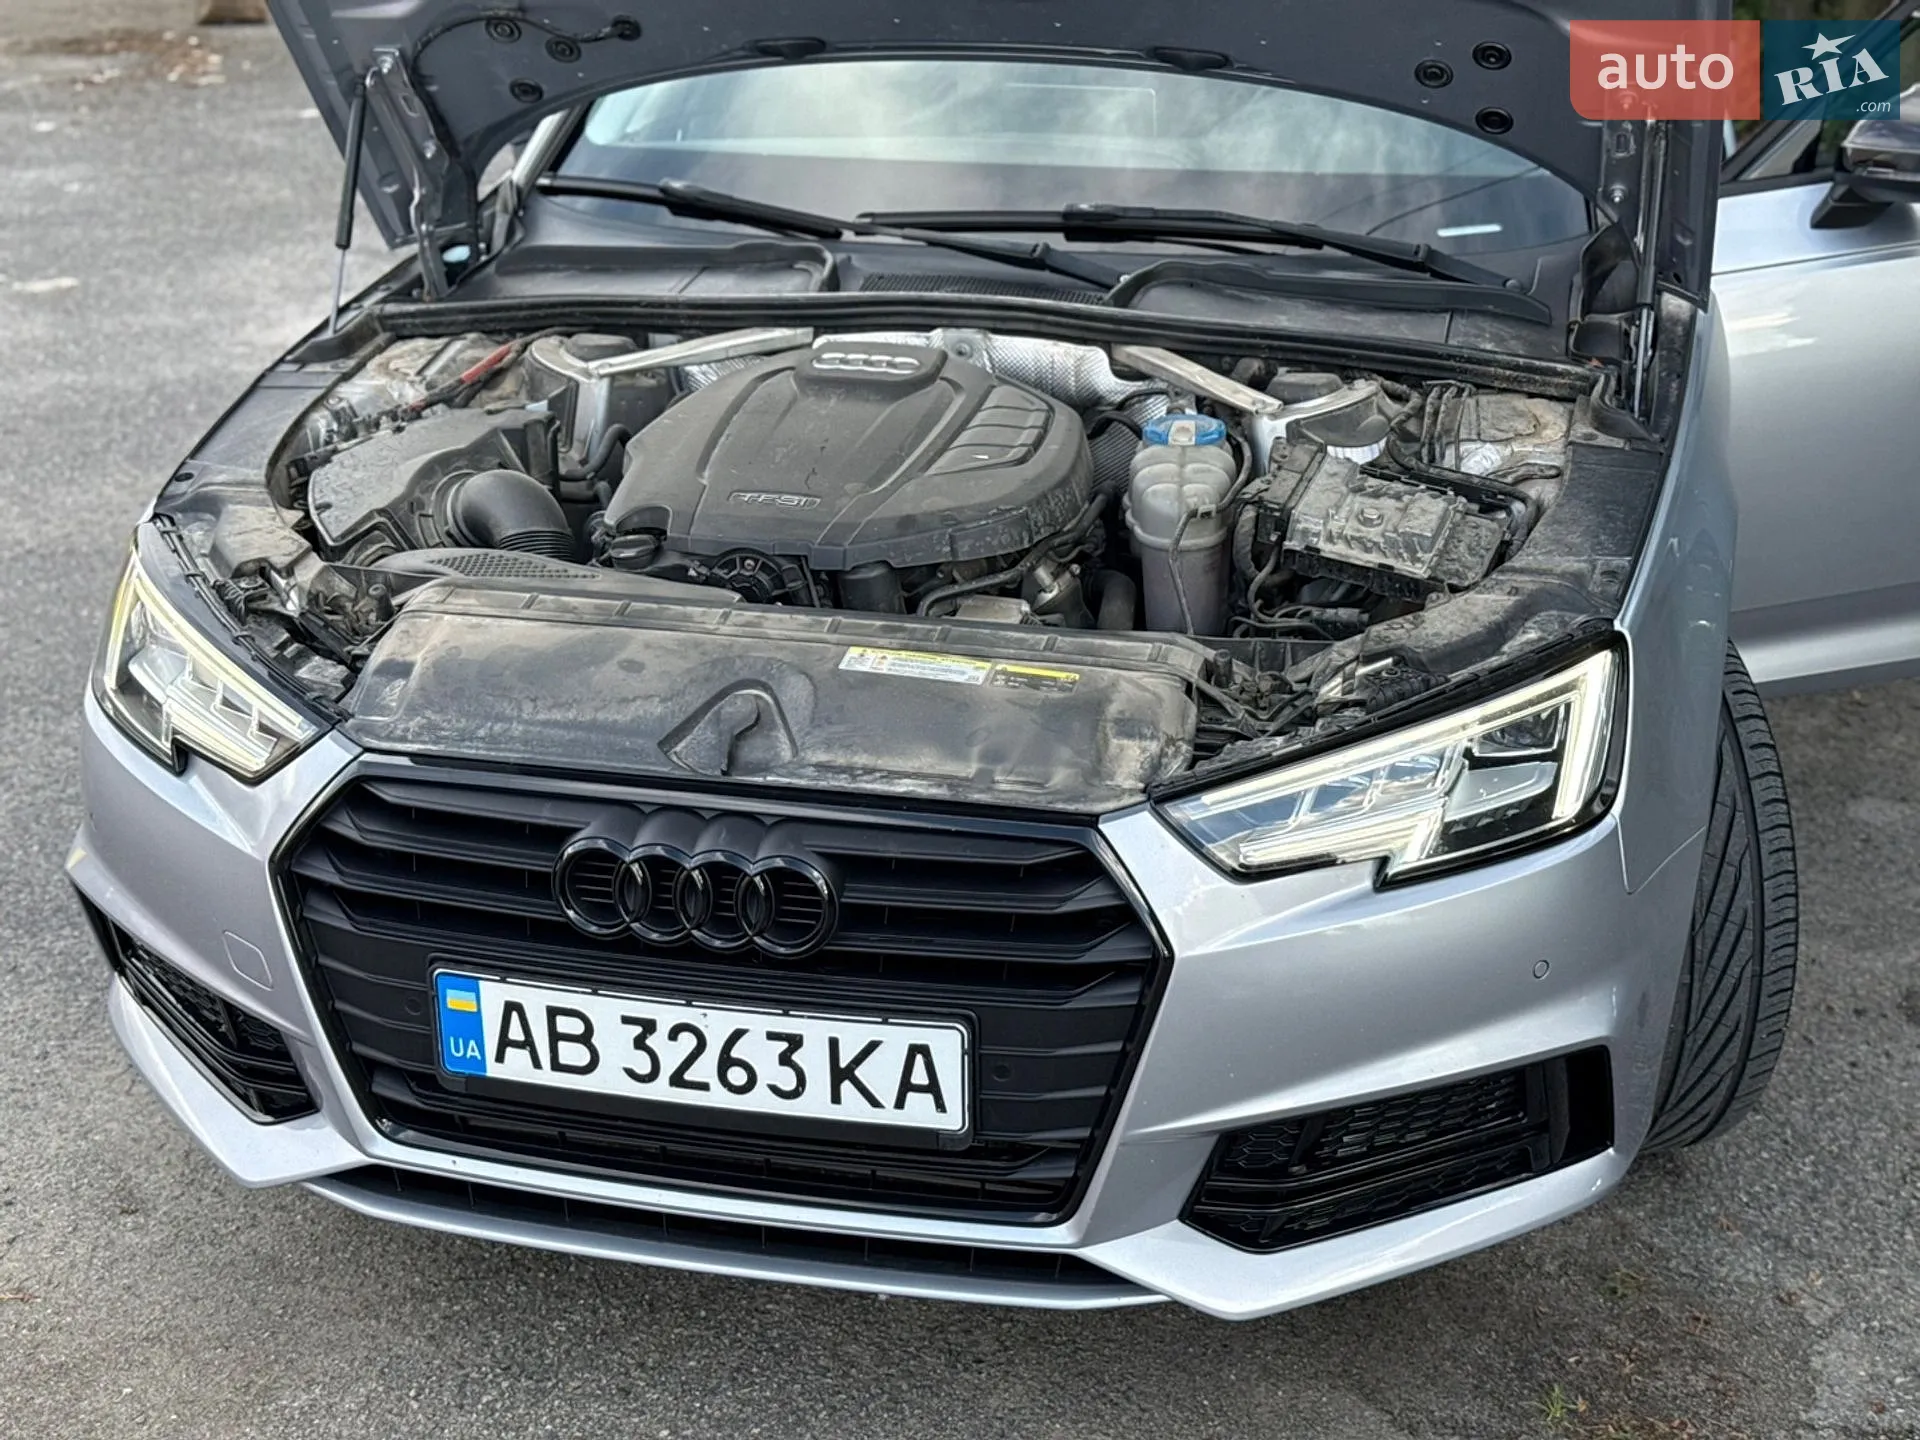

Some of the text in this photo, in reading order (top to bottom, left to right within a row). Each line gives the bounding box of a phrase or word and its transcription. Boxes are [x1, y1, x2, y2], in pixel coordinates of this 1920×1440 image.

[450, 1036, 482, 1061] UA
[494, 1000, 948, 1114] AB 3263 KA
